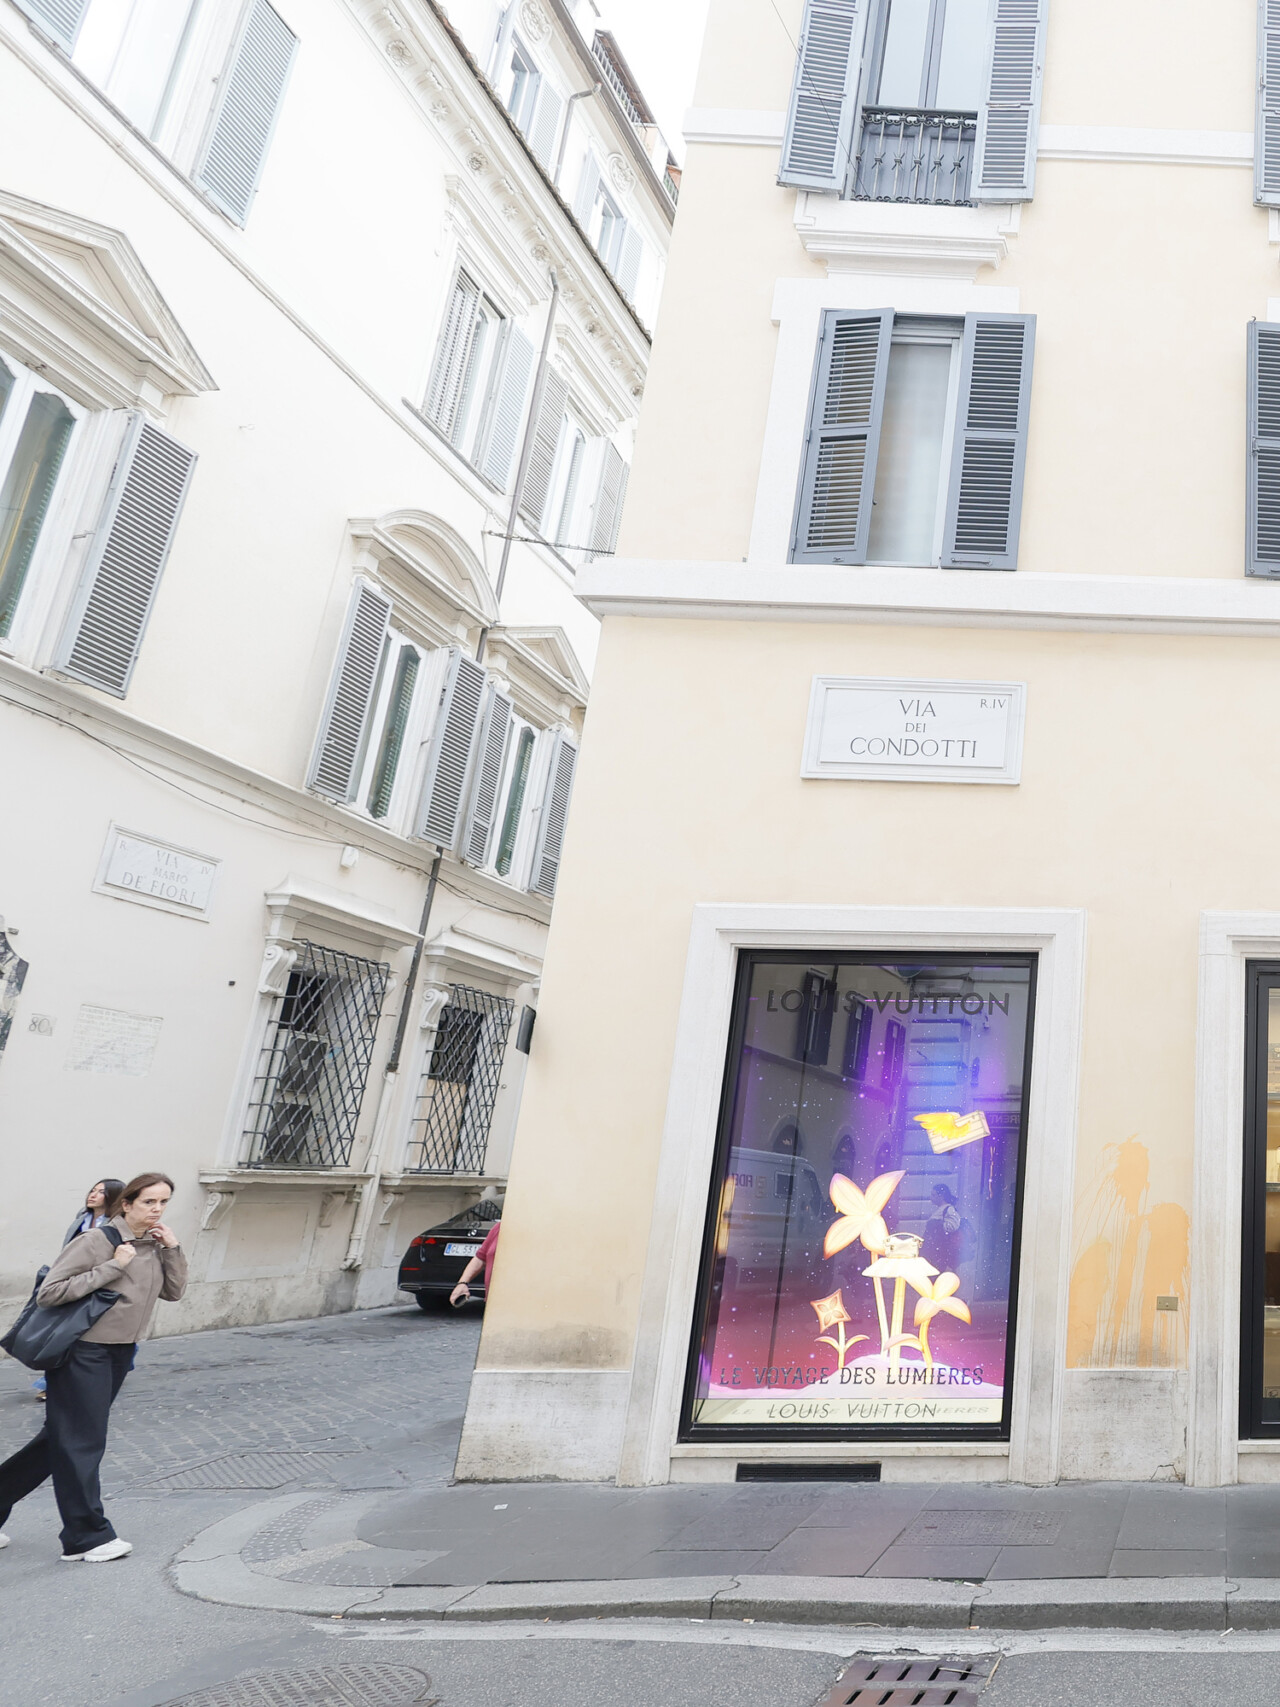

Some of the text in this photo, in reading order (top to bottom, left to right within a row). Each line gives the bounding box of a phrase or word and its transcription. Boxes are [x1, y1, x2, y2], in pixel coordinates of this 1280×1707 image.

[899, 699, 937, 718] VIA
[904, 722, 927, 733] DEI
[849, 736, 978, 759] CONDOTTI
[156, 850, 179, 869] VIA
[152, 867, 189, 884] MARIO
[150, 880, 197, 904] FIORI
[766, 989, 1011, 1017] LOUIS VUITTON
[719, 1366, 985, 1386] LE VOYAGE DES LUMIERES
[768, 1402, 831, 1419] LOUIS
[847, 1402, 938, 1419] VUITTON
